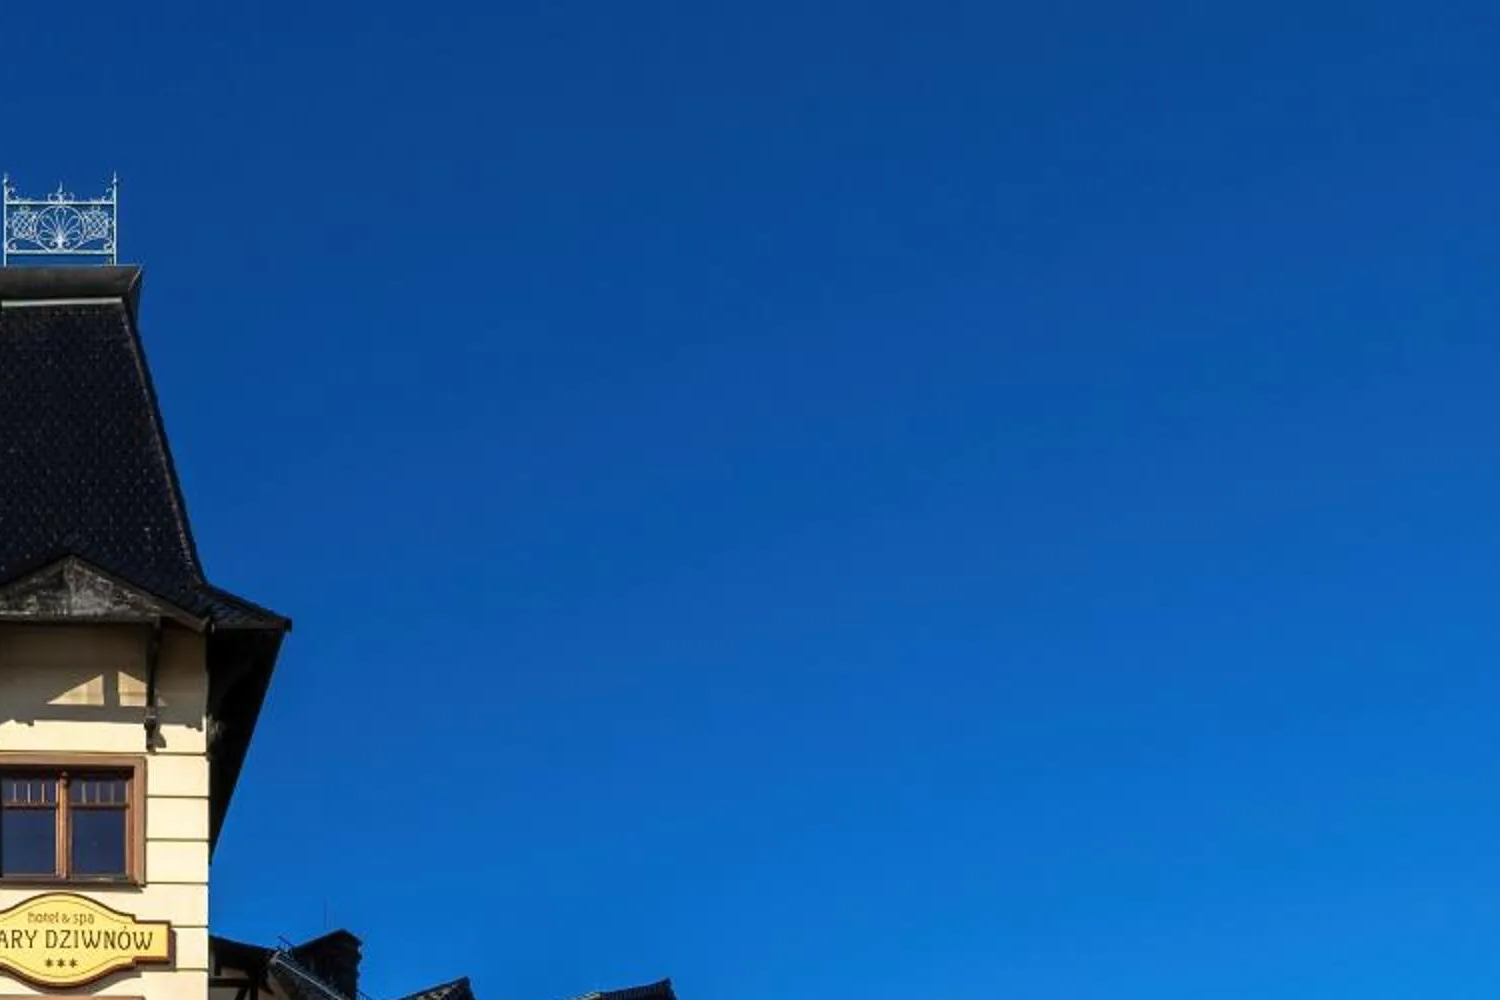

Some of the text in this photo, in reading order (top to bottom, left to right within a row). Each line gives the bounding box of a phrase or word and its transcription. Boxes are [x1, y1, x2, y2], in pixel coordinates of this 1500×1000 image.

[27, 912, 59, 924] hotel
[73, 914, 95, 926] spa
[45, 926, 154, 950] DZIWNÓW
